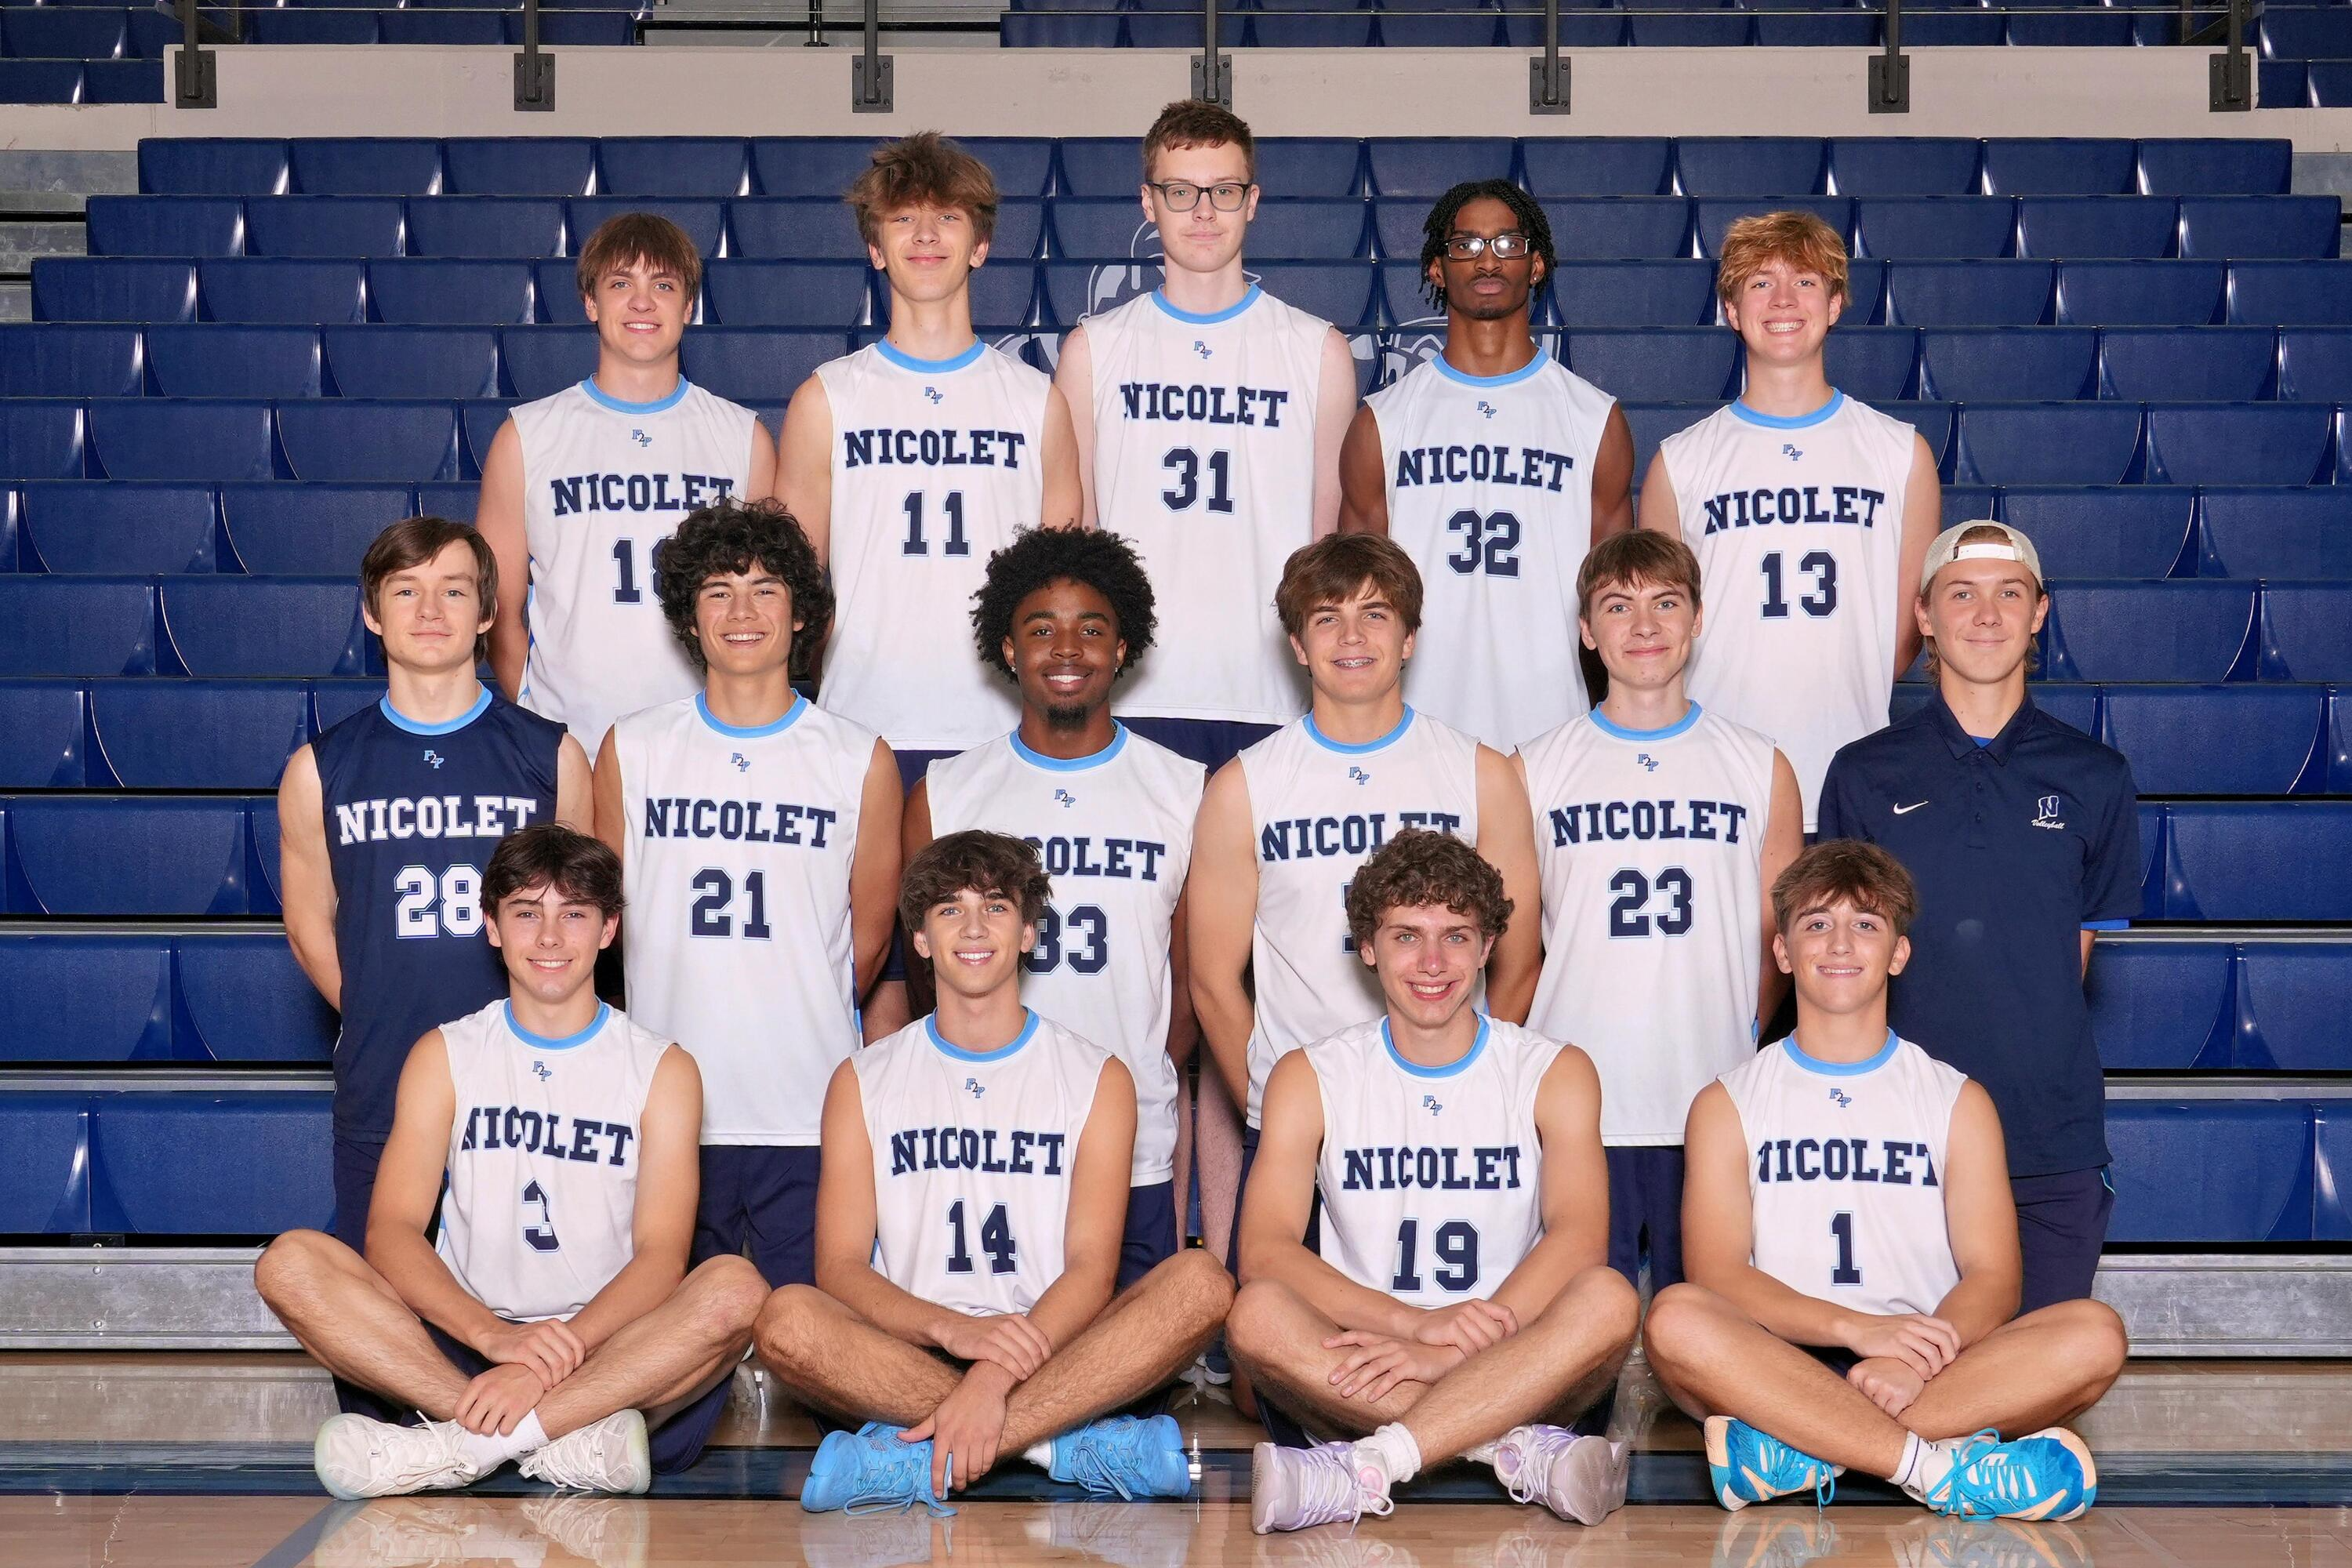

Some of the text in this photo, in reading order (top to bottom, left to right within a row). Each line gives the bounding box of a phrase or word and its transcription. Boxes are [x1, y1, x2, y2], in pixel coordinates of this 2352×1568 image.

[1119, 381, 1289, 428] NICOLET
[843, 428, 1026, 470] NICOLET
[1395, 443, 1574, 493] NICOLET
[551, 474, 734, 516] NICOLET
[1161, 446, 1235, 514] 31
[902, 490, 971, 557] 11
[1703, 485, 1886, 536] NICOLET
[1446, 508, 1523, 579] 32
[1760, 550, 1838, 619] 13
[336, 795, 538, 846] NICOLET
[644, 797, 837, 849] NICOLET
[1548, 800, 1748, 849] NICOLET
[2031, 819, 2065, 829] Volleyball
[2038, 796, 2059, 820] N
[394, 864, 486, 938] 28
[690, 867, 771, 941] 21
[1608, 866, 1693, 938] 23
[1022, 904, 1109, 975] 33
[890, 1126, 1065, 1177] NICOLET
[1341, 1145, 1522, 1191] NICOLET
[522, 1177, 561, 1252] 3
[946, 1199, 1018, 1276] 14
[1391, 1218, 1480, 1293] 19
[1829, 1210, 1863, 1286] 1
